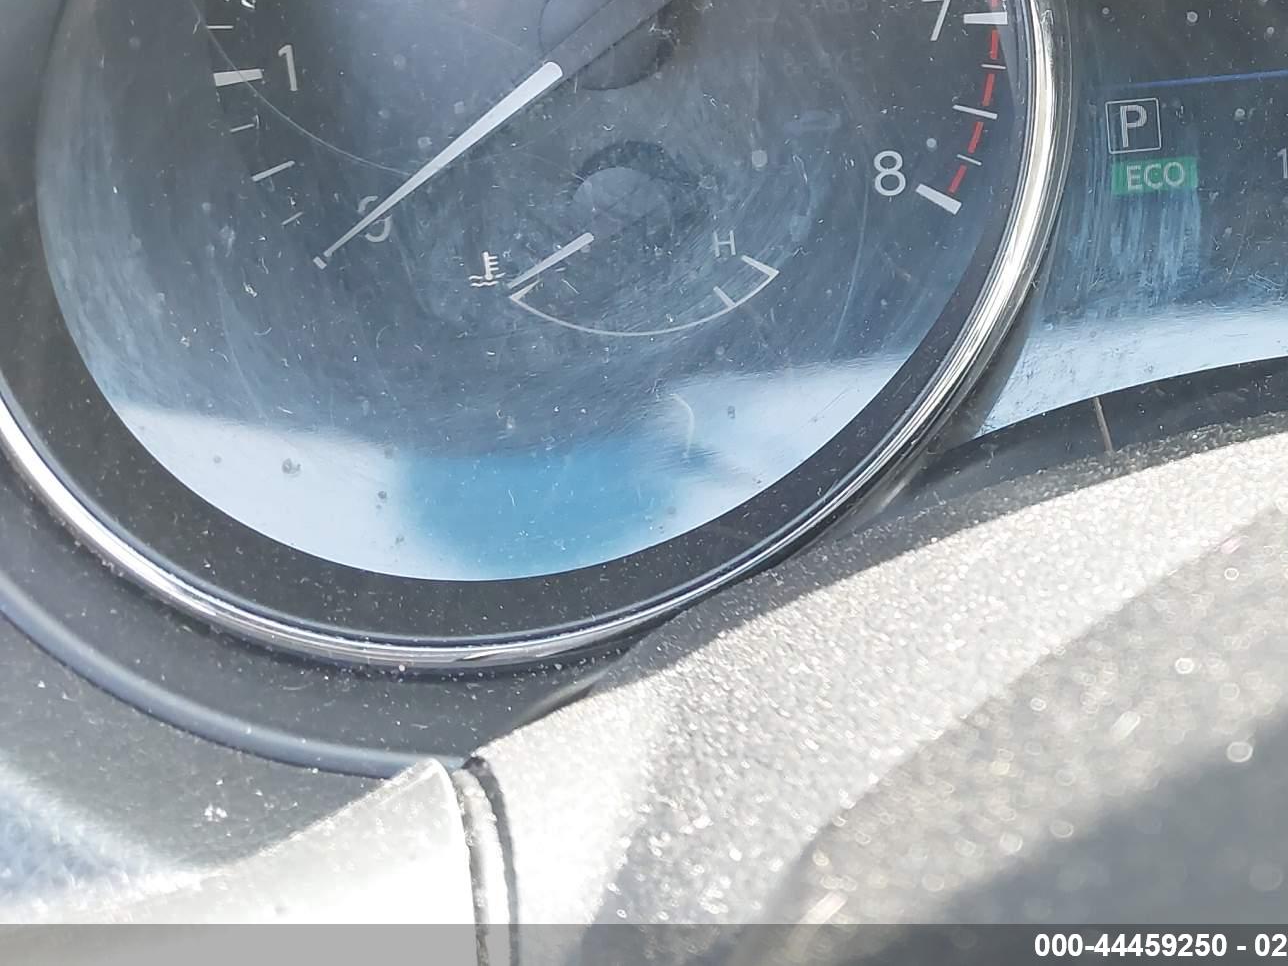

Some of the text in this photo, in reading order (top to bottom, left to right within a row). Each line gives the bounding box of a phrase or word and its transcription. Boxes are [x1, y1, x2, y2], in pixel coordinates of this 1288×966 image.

[277, 45, 299, 92] 1
[1119, 104, 1148, 149] P
[873, 150, 907, 197] 8
[1126, 161, 1185, 191] ECO
[714, 231, 737, 257] H
